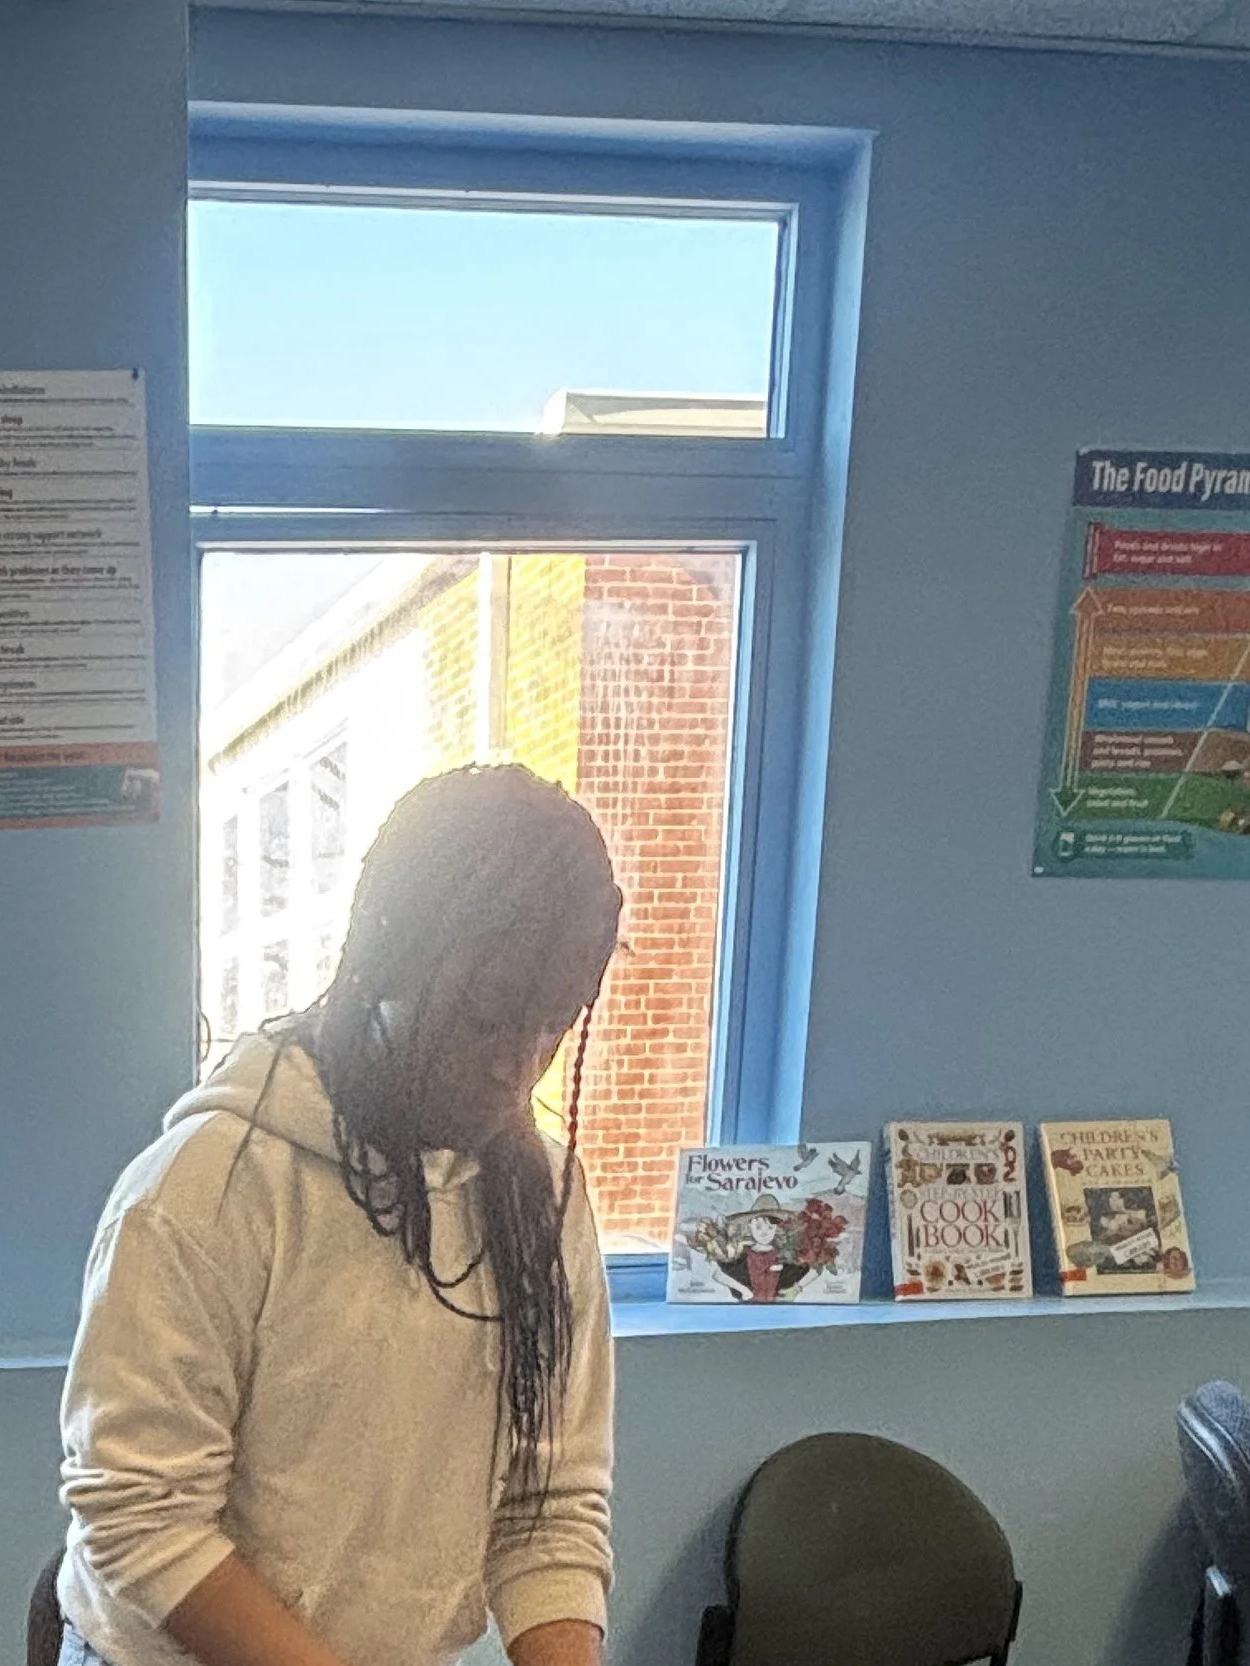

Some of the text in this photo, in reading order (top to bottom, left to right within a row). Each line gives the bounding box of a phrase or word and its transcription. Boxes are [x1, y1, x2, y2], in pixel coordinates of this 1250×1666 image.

[1092, 459, 1130, 492] The
[1133, 461, 1188, 493] Food
[1061, 1129, 1159, 1144] CHILDREN'S
[688, 1154, 770, 1172] Flowers
[1083, 1146, 1143, 1161] PARTY
[1086, 1163, 1145, 1177] CAKES
[685, 1168, 799, 1194] for Sarajevo
[920, 1200, 1000, 1223] COOK
[923, 1223, 1004, 1248] BOOK
